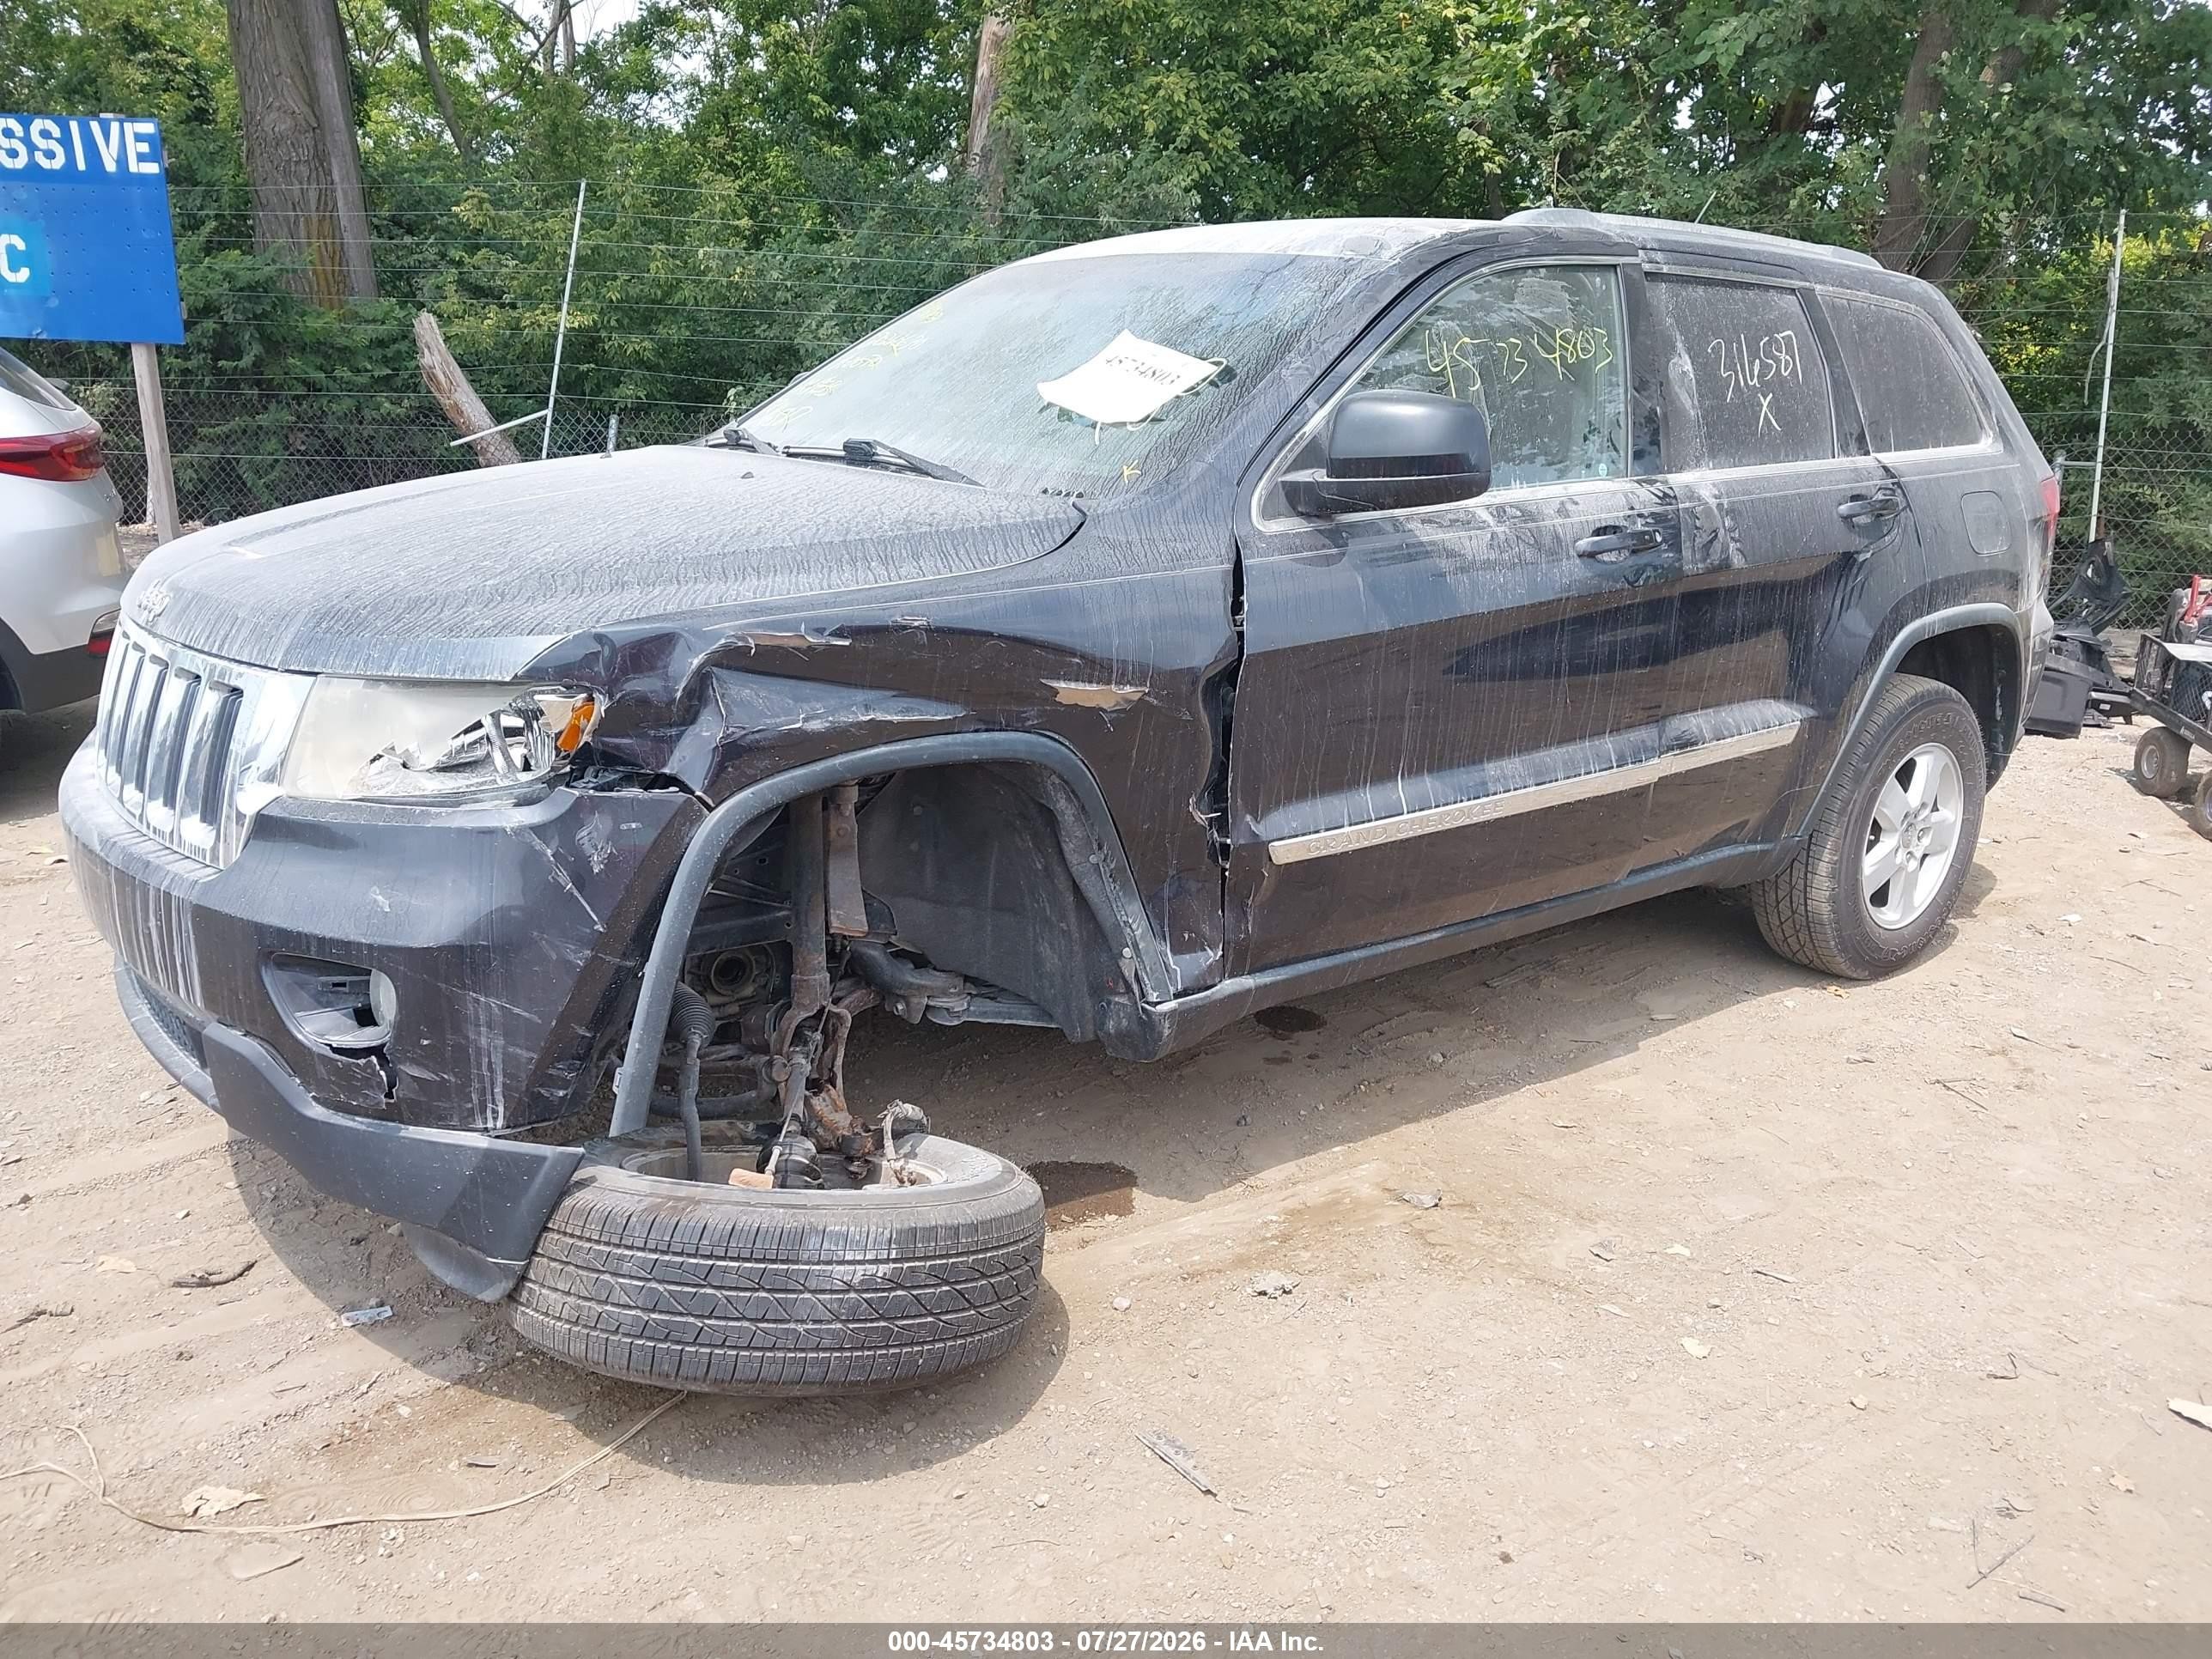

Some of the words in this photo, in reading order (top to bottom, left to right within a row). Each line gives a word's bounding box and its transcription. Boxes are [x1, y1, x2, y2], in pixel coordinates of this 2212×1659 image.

[0, 118, 161, 173] SSIVE
[0, 233, 30, 283] C
[1758, 392, 1783, 439] X
[1307, 826, 1389, 857] GRAND
[1395, 800, 1506, 836] CHEROKEE
